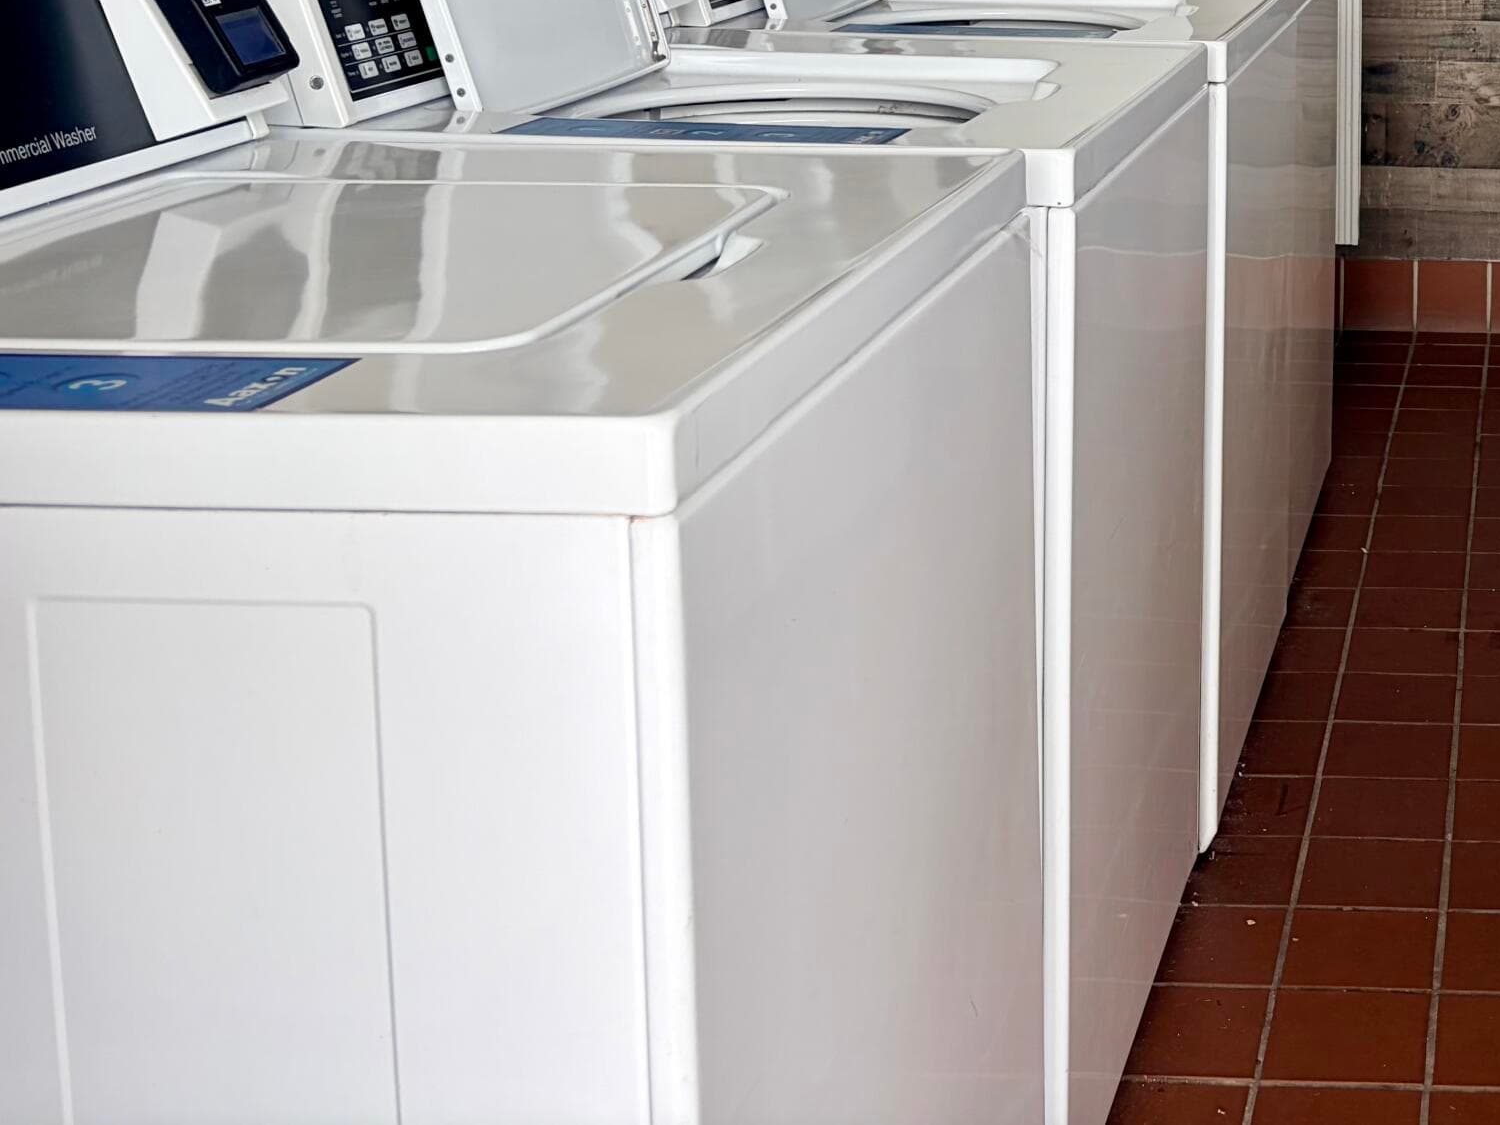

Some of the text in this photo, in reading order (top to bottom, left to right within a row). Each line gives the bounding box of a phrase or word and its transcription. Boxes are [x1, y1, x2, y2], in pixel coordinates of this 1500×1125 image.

[50, 126, 97, 150] Washer
[68, 379, 127, 392] 3
[204, 366, 307, 408] Aaxon
